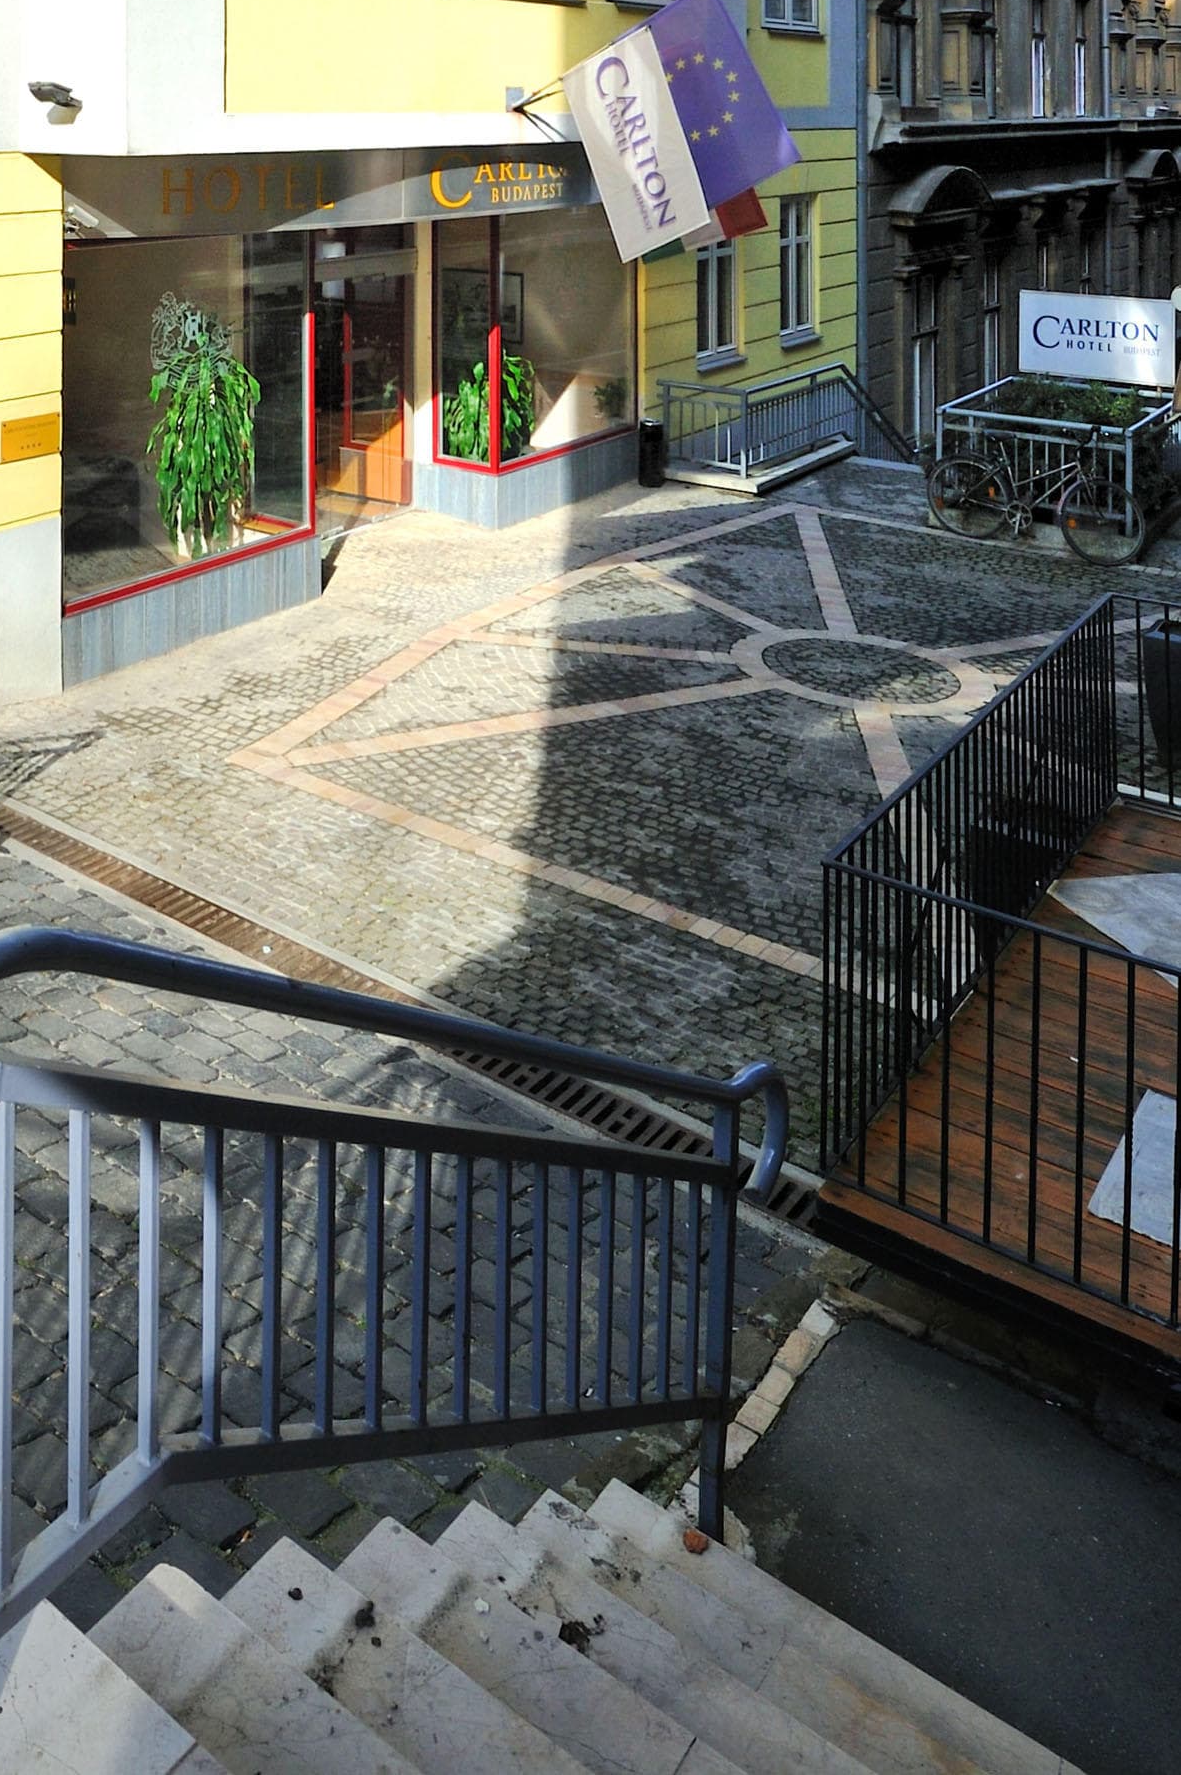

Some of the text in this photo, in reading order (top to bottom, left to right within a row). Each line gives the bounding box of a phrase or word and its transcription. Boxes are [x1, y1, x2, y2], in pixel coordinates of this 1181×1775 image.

[596, 56, 677, 227] CARLTON
[605, 100, 631, 156] HOTEL
[162, 152, 566, 216] HOTEL CARLT
[490, 182, 564, 204] BUDAPEST
[1032, 315, 1160, 349] CARLTON
[1066, 339, 1112, 353] HOTEL
